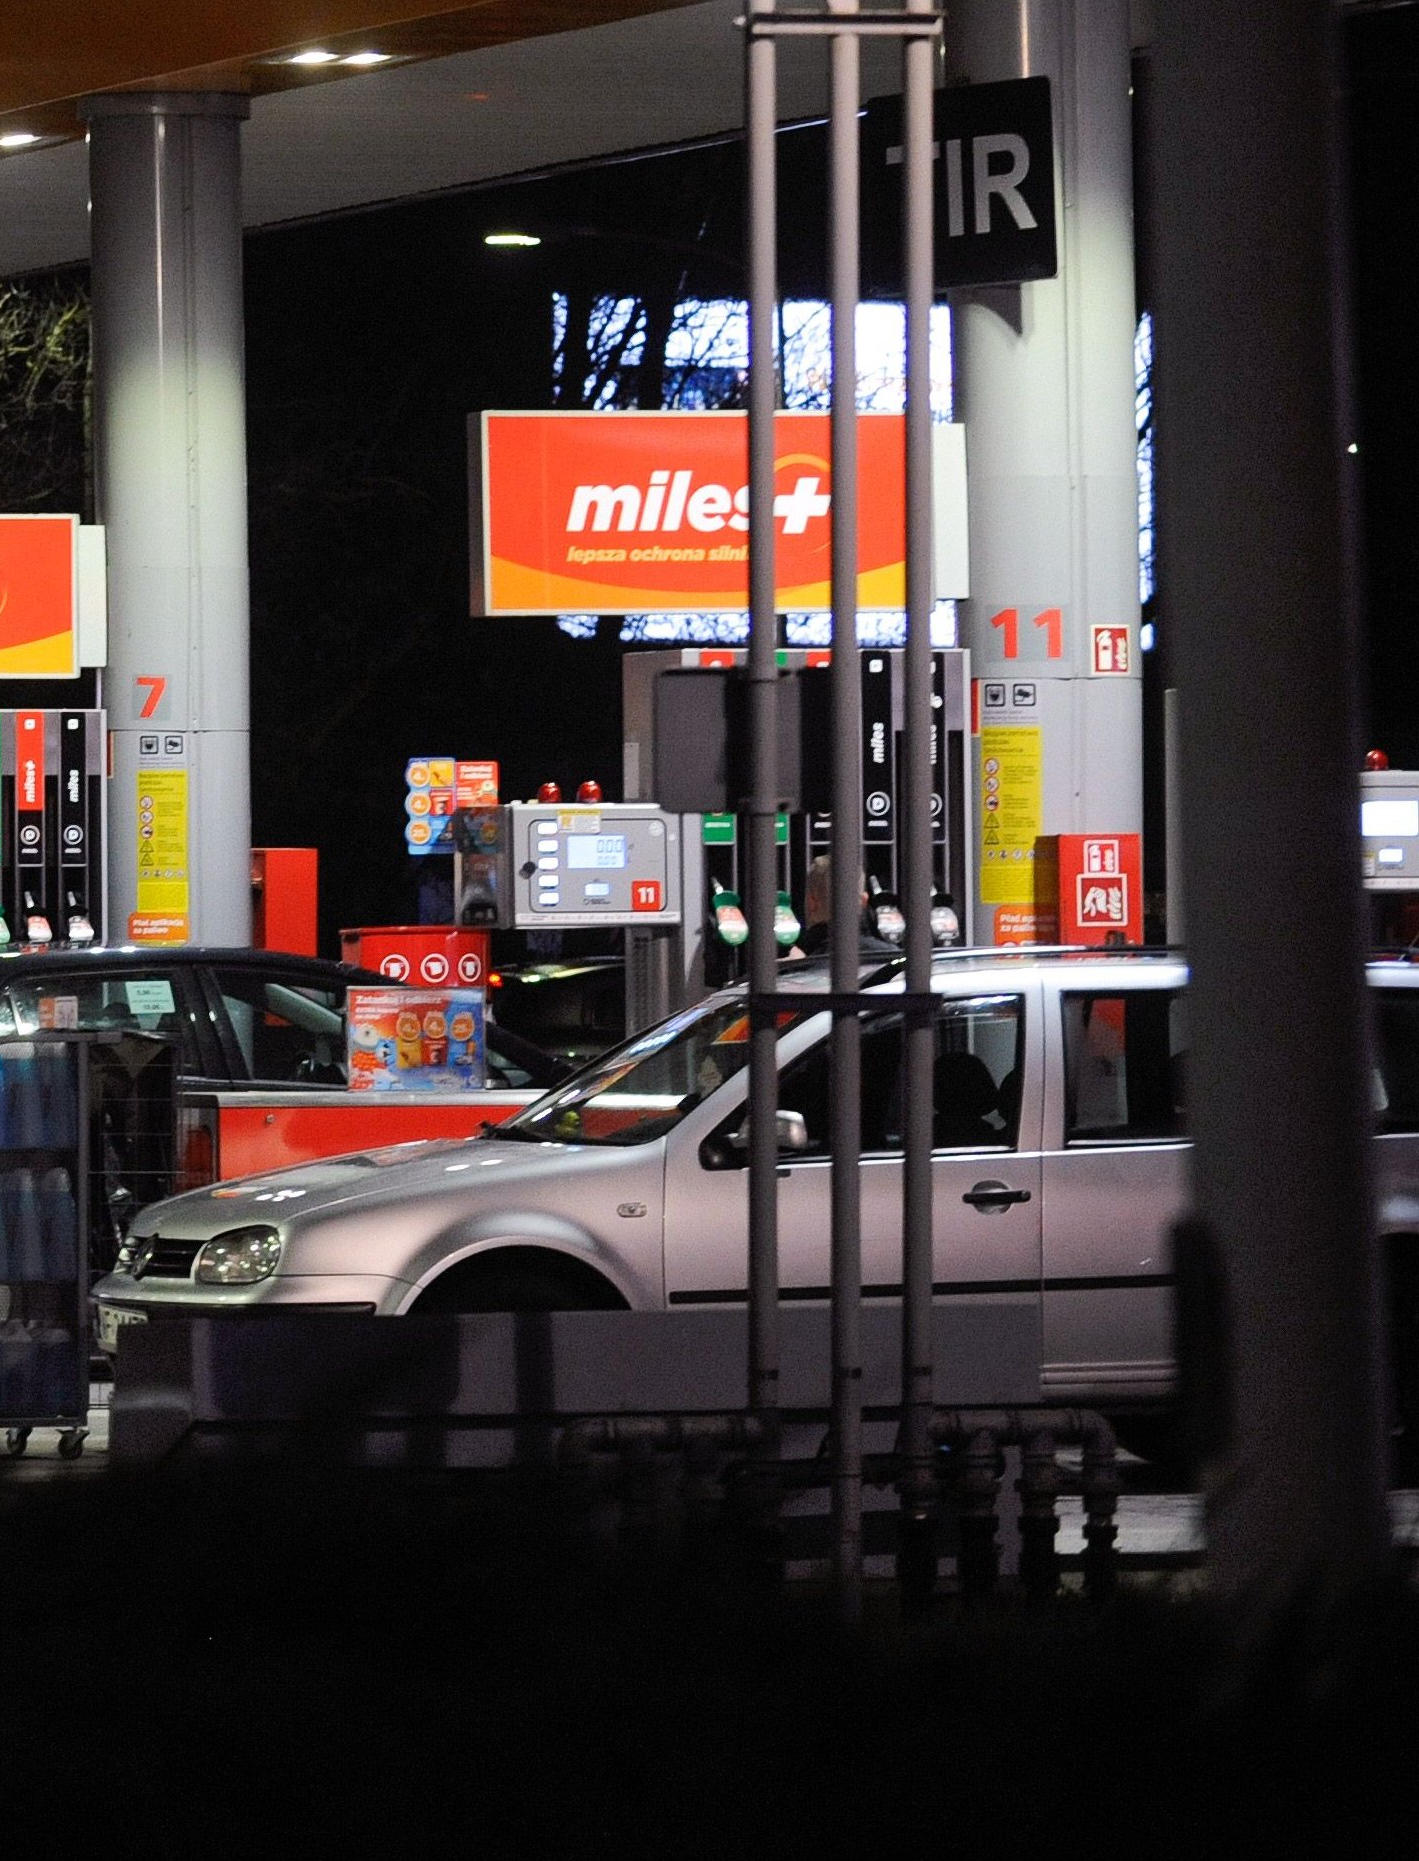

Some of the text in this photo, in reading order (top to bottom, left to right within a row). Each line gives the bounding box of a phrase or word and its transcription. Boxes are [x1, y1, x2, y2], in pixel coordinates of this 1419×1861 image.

[567, 546, 626, 564] lepsza
[630, 547, 704, 563] ochrona
[990, 608, 1062, 659] 11
[135, 675, 168, 719] 7
[637, 887, 656, 904] 11
